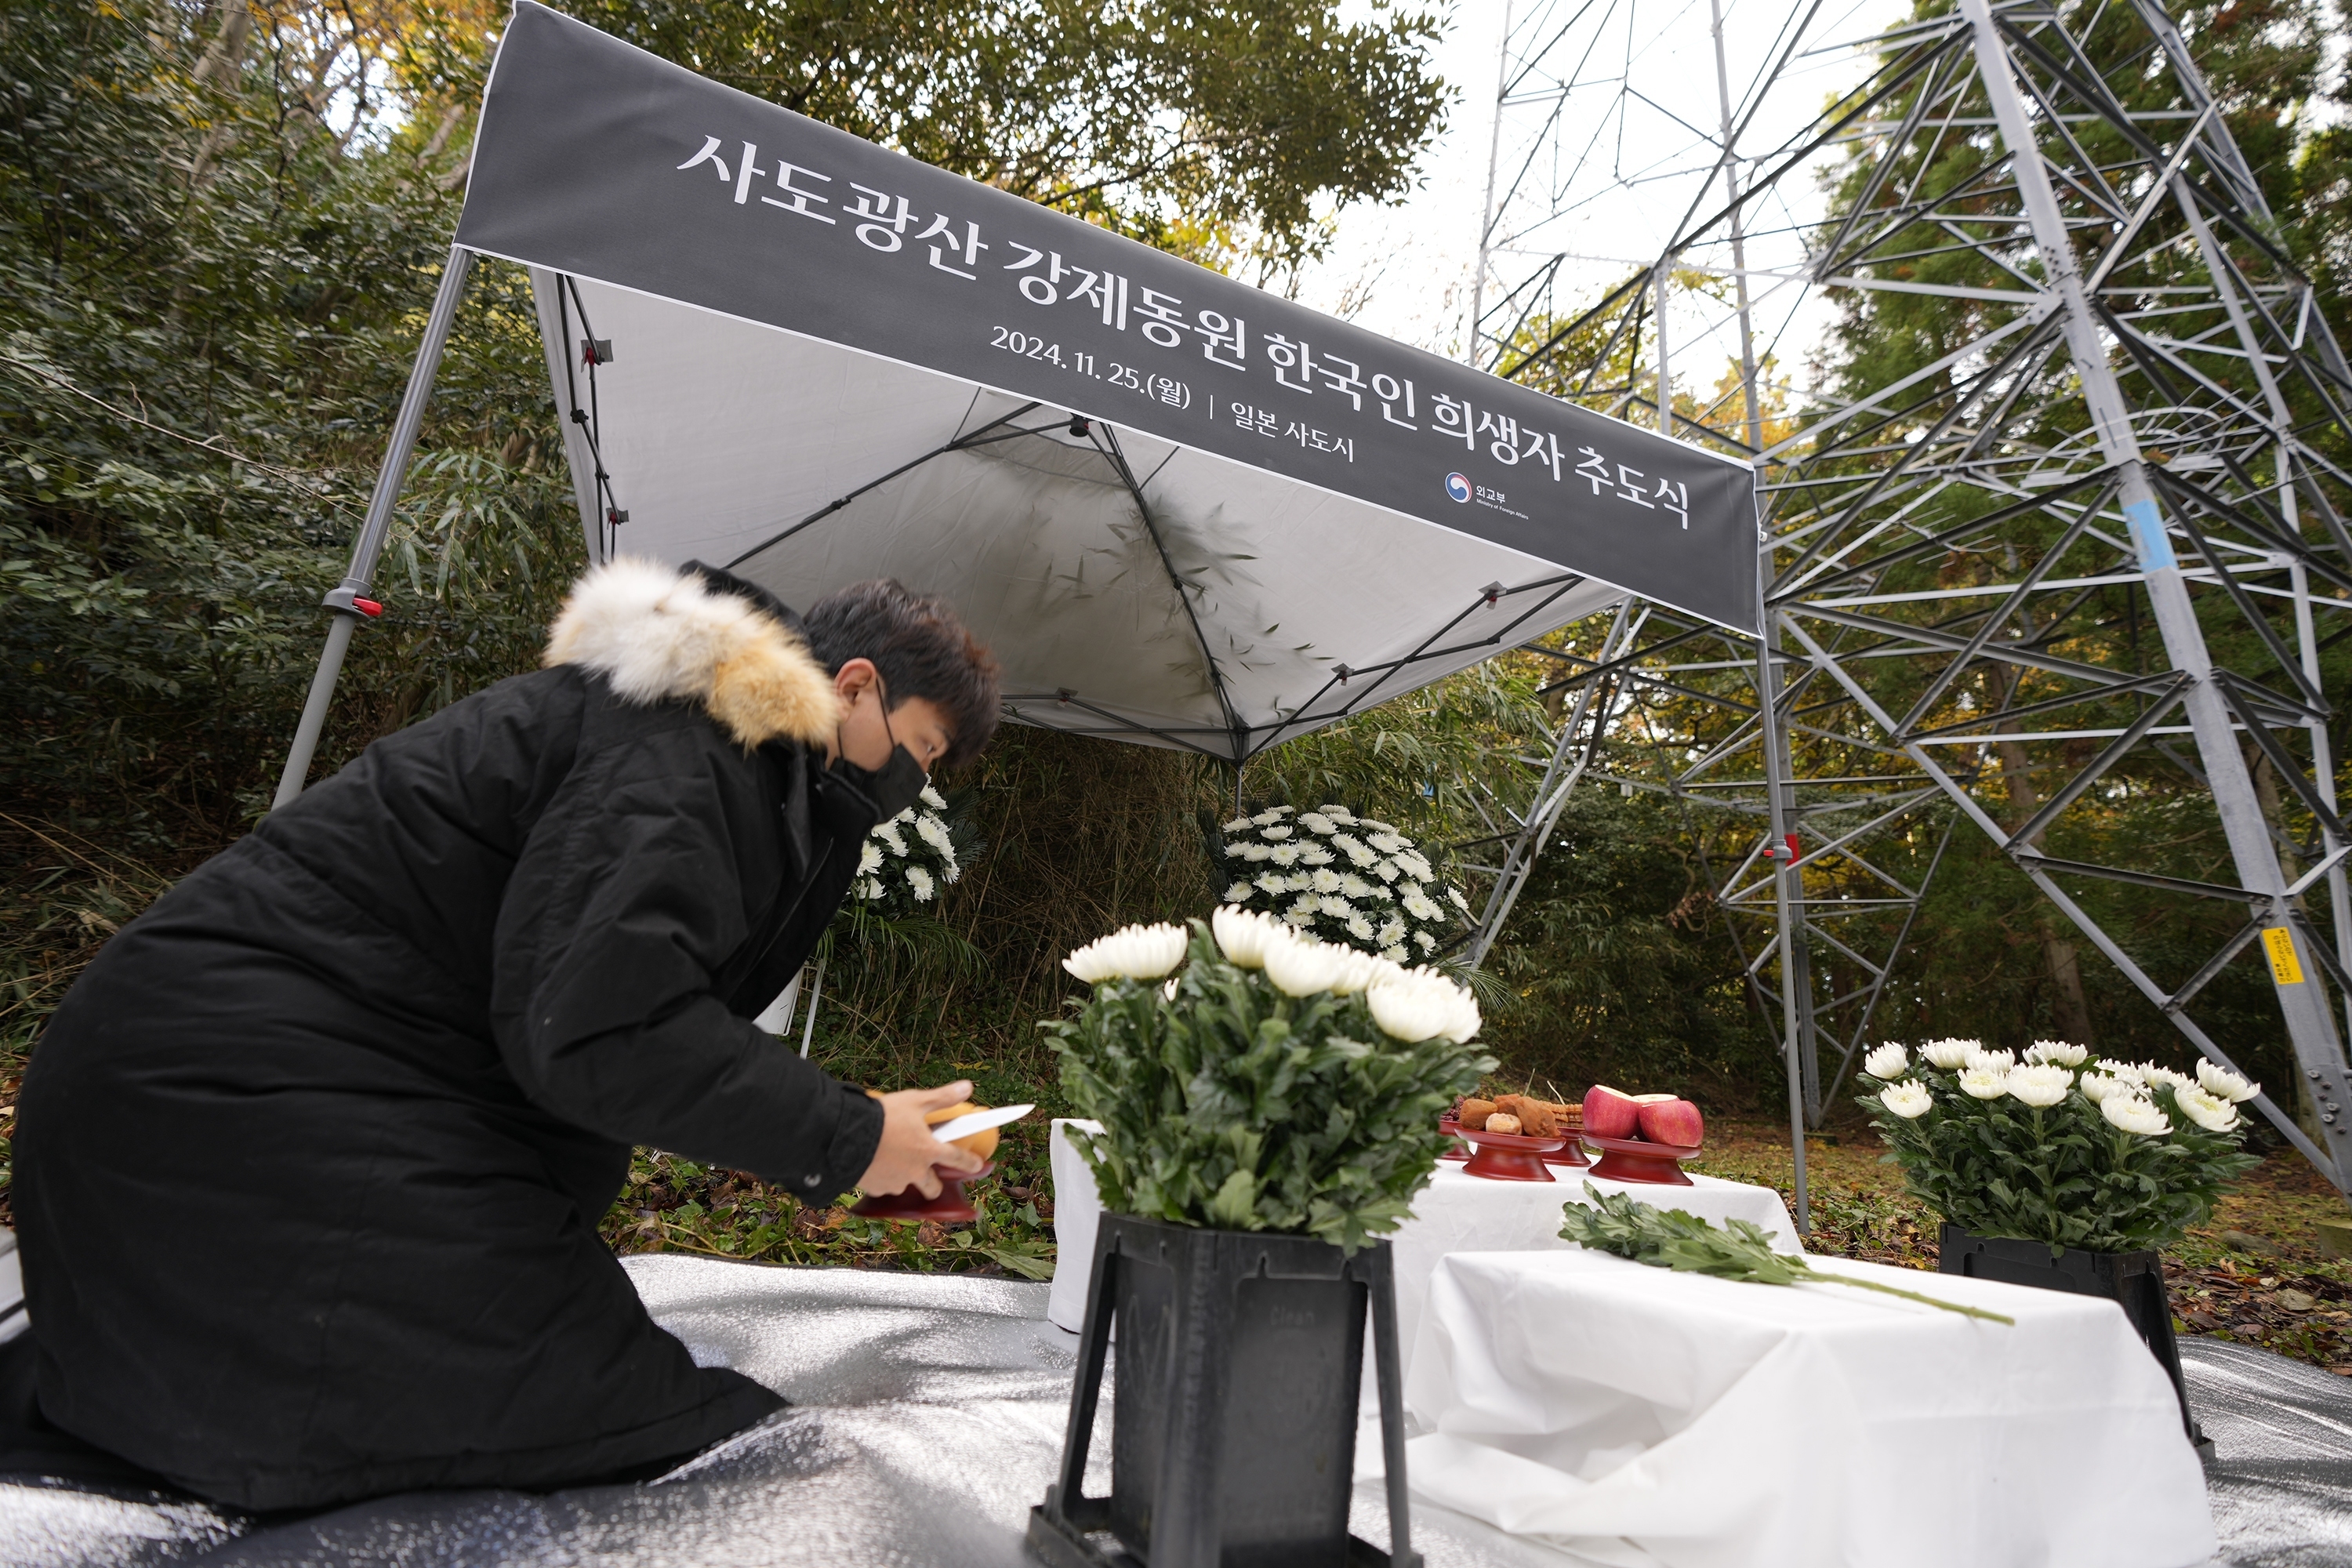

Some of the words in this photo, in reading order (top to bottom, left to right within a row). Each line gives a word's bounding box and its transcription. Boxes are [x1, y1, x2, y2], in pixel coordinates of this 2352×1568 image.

[677, 135, 989, 280] 사도광산
[1004, 241, 1246, 372] 강제동원
[1264, 332, 1417, 430] 한국인
[1432, 394, 1565, 481] 희생자
[1575, 446, 1688, 530] 추도식
[990, 326, 1067, 369] 2024.
[1075, 352, 1102, 379] 11.
[1108, 363, 1191, 409] 25.(월)
[1231, 401, 1279, 438] 일본
[1284, 422, 1354, 463] 사도시
[1476, 485, 1506, 504] 외교부
[1476, 498, 1494, 509] Ministry
[1499, 506, 1515, 516] Foreign
[1515, 511, 1529, 521] Affairs
